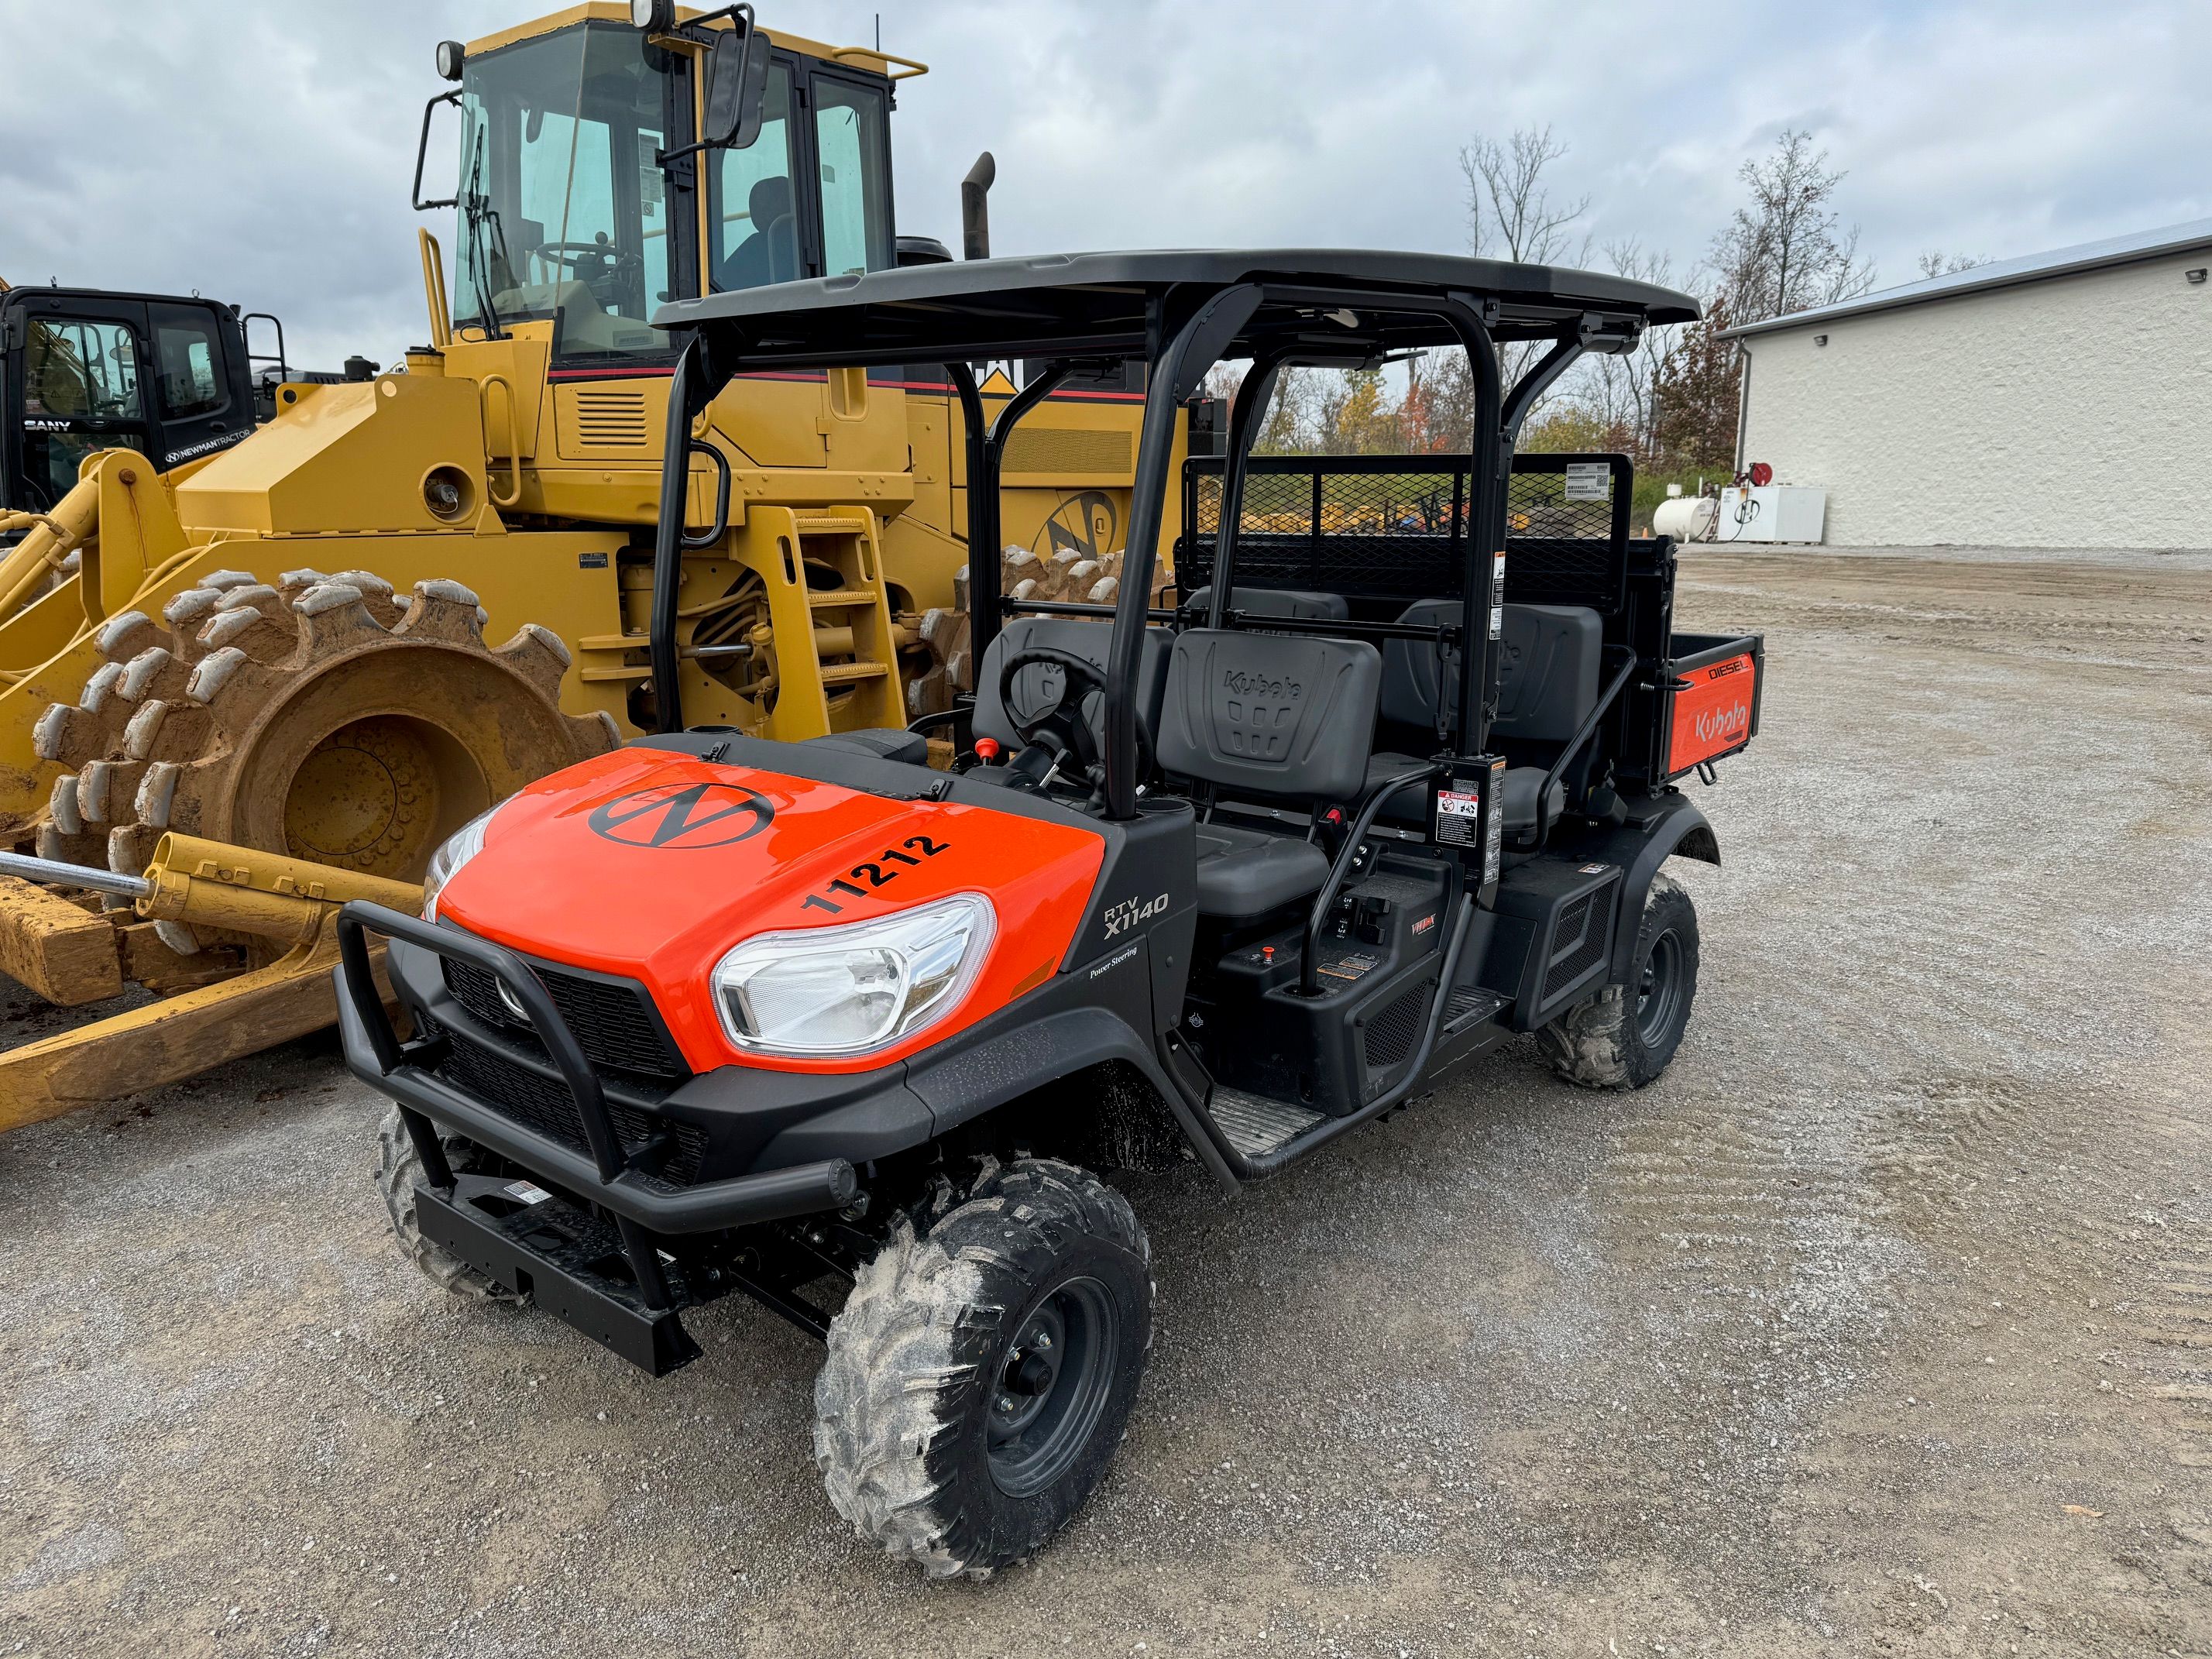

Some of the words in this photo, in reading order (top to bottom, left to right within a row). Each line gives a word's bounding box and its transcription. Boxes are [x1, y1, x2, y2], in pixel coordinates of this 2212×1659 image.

[24, 420, 70, 432] SANY
[1224, 670, 1302, 700] Kubota
[1708, 660, 1748, 680] DIESEL
[1695, 699, 1747, 742] Kubota
[1451, 792, 1472, 801] DANGER
[800, 836, 952, 915] 11212
[1104, 896, 1139, 922] RTV
[1104, 893, 1169, 940] X1140
[1090, 963, 1111, 980] Power
[1111, 946, 1137, 967] Steering
